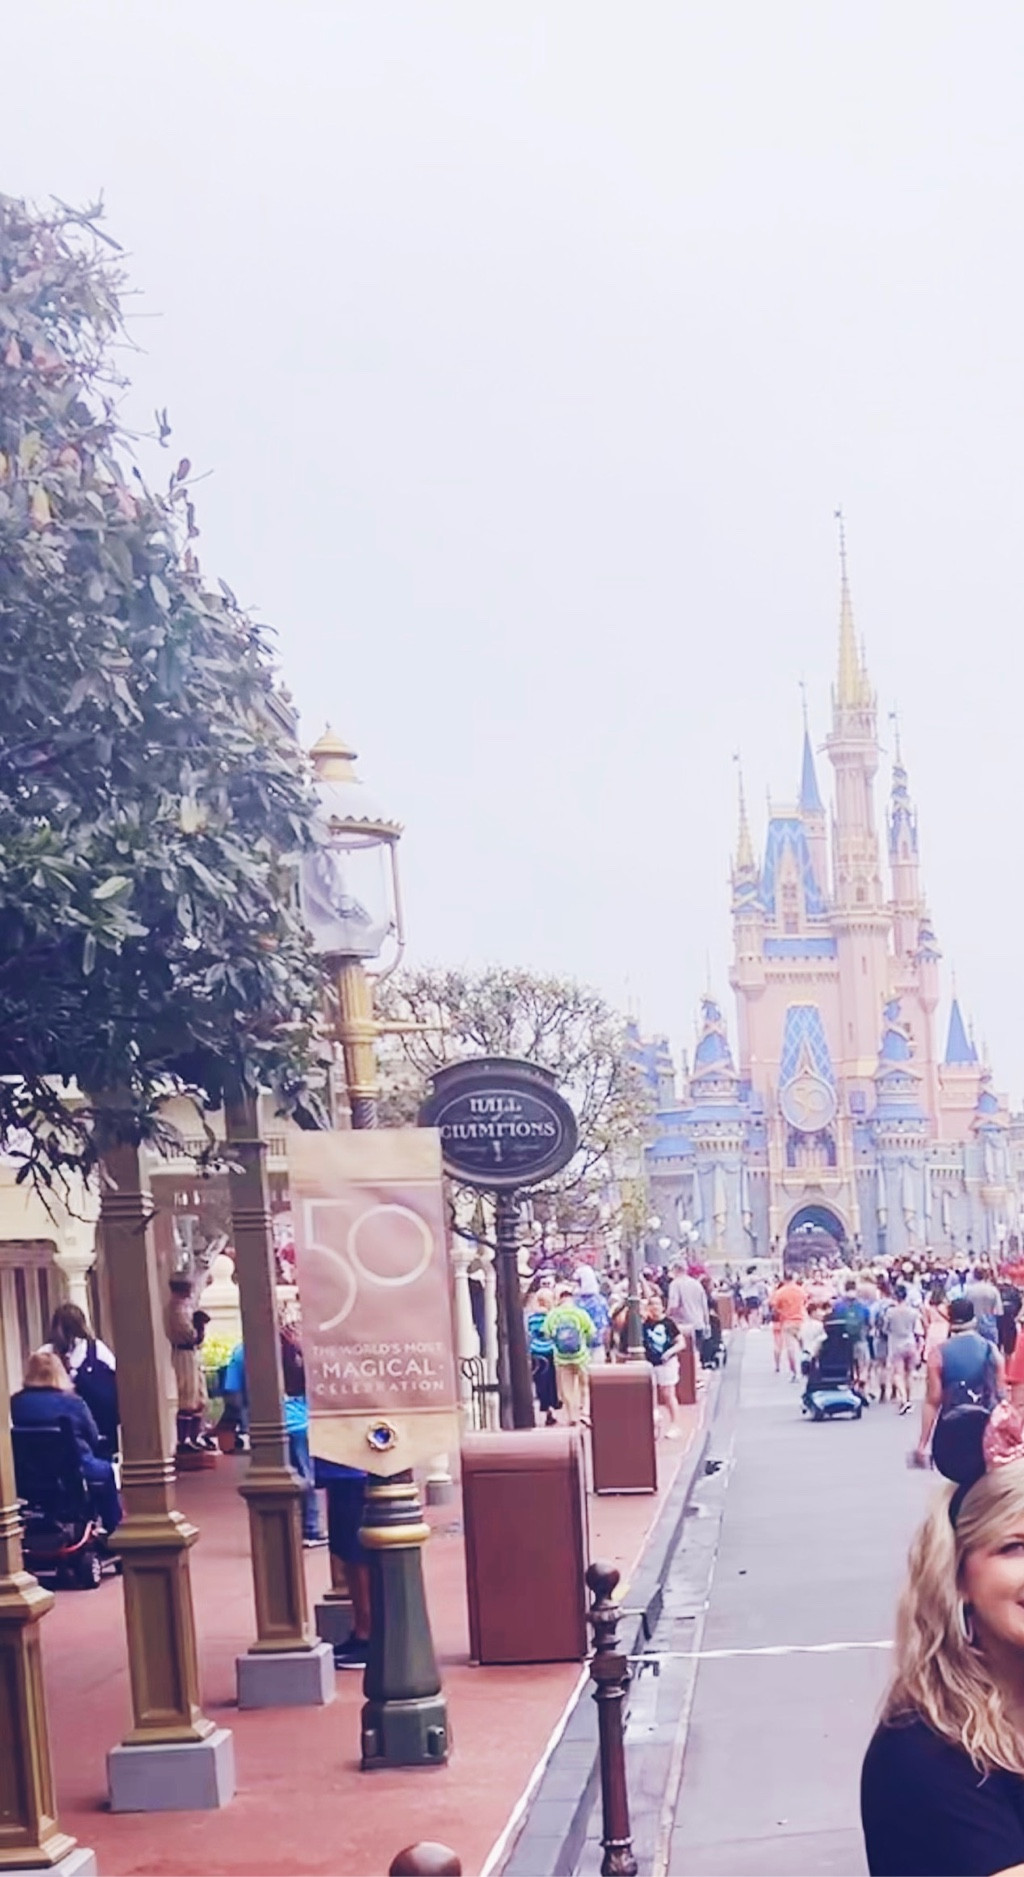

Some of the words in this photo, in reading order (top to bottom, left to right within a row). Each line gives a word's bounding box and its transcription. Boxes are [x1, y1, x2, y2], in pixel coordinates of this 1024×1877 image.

[470, 1098, 522, 1113] HALL
[304, 1198, 433, 1331] 50
[313, 1345, 336, 1356] THE
[405, 1342, 443, 1353] MOST
[322, 1358, 436, 1378] MAGICAL
[315, 1380, 444, 1395] CELEBRATION
